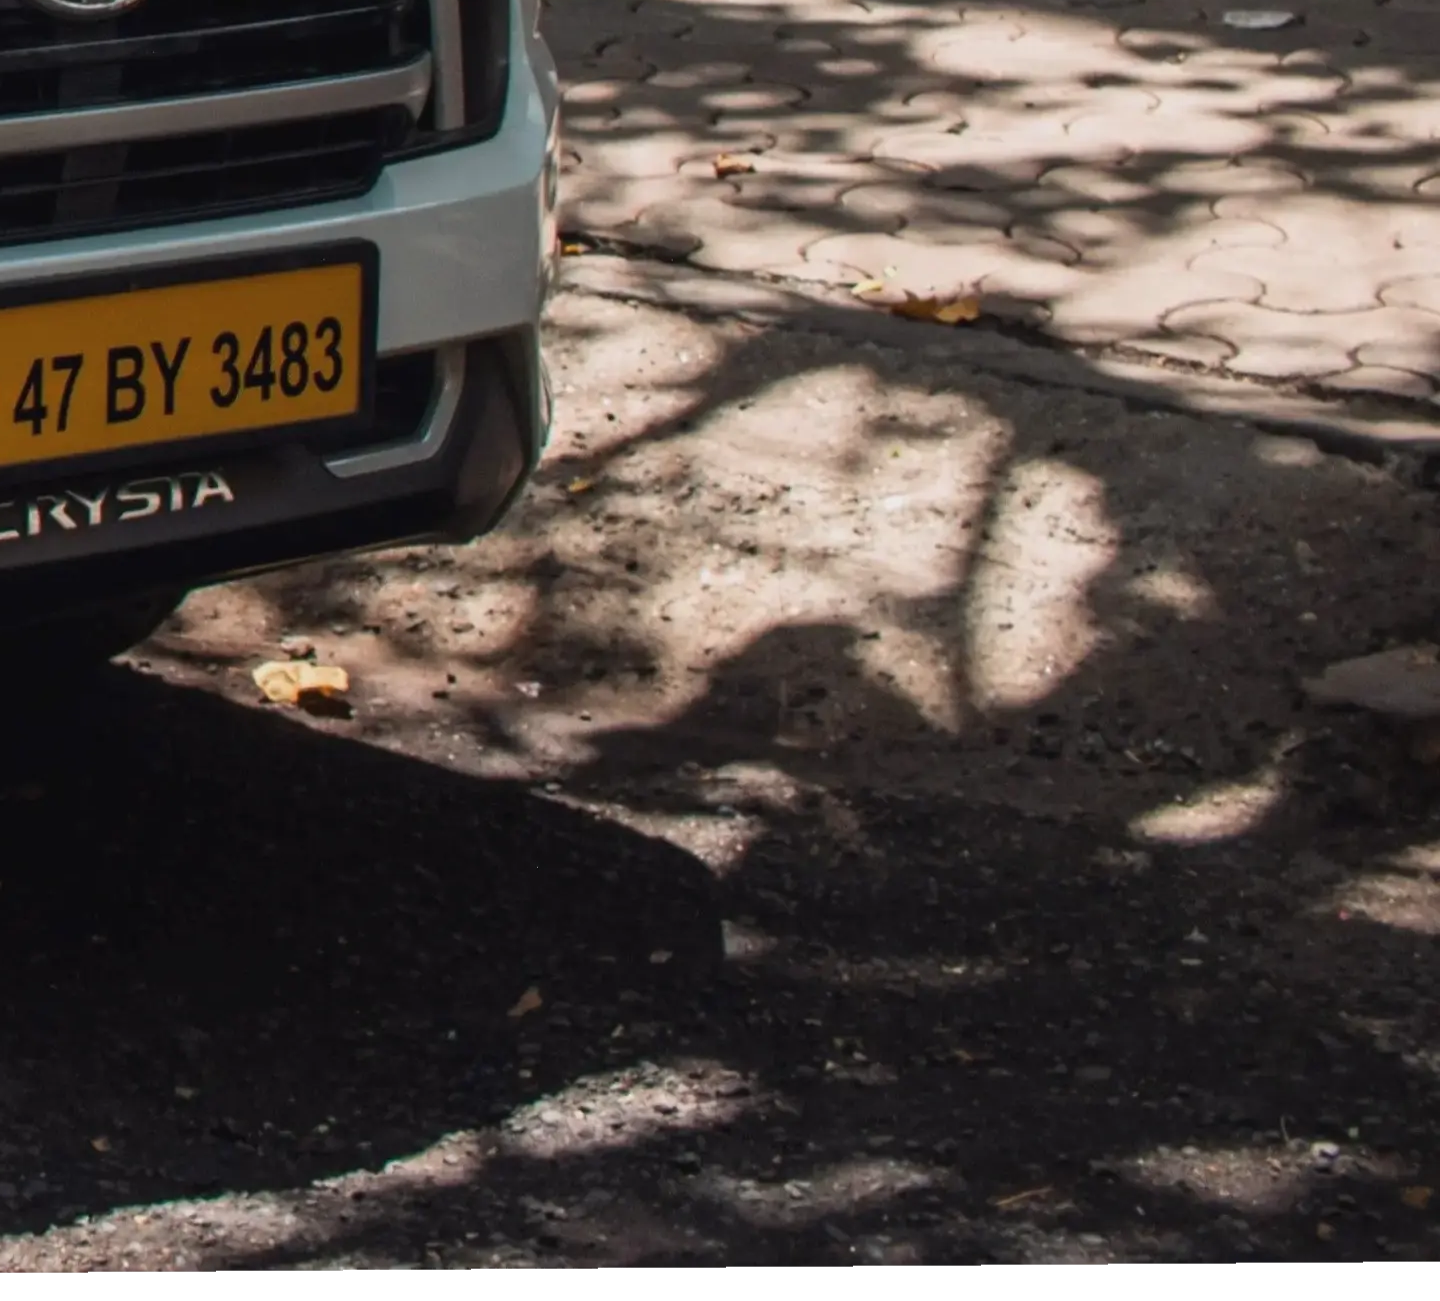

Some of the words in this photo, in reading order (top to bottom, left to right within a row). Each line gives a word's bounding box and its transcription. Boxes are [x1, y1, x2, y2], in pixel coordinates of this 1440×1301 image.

[13, 354, 84, 435] 47
[106, 337, 191, 424] BY
[209, 316, 343, 408] 3483
